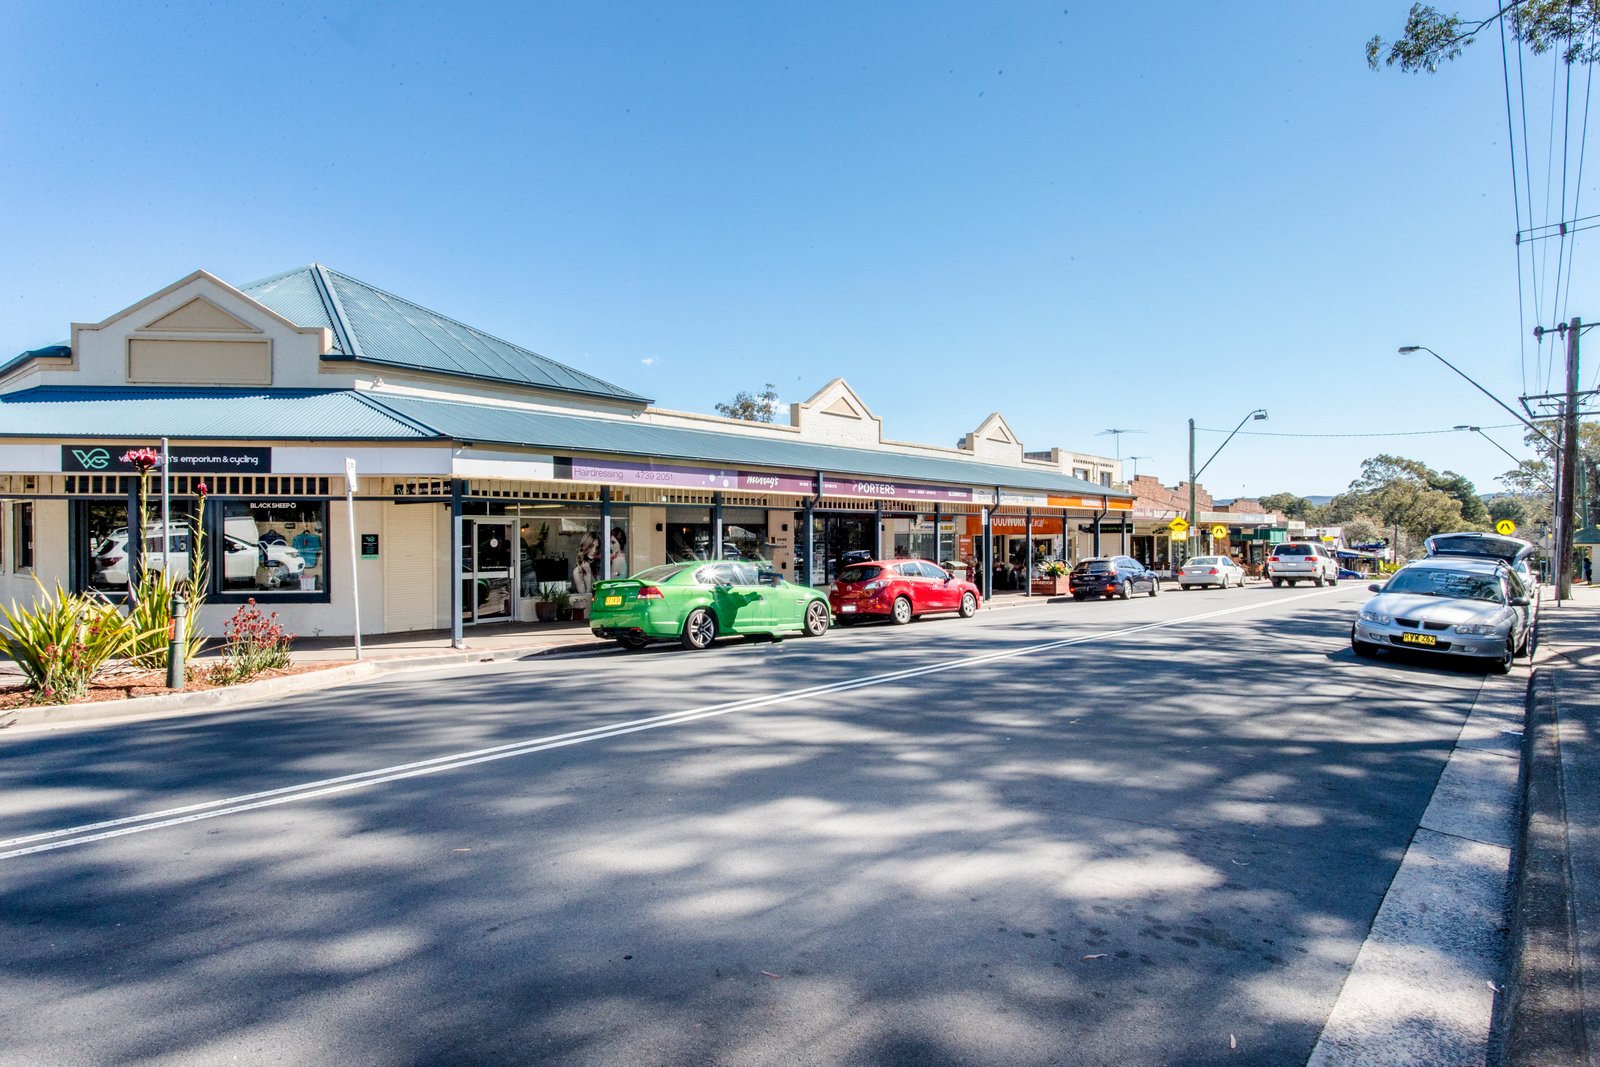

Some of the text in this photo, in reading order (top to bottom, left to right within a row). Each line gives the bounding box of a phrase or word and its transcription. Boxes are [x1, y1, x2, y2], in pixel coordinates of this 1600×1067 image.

[180, 455, 222, 466] emporium
[222, 455, 229, 463] &
[229, 454, 259, 466] cycling
[574, 468, 673, 481] Hairdressing 4739 2051
[858, 482, 896, 495] PORTERS
